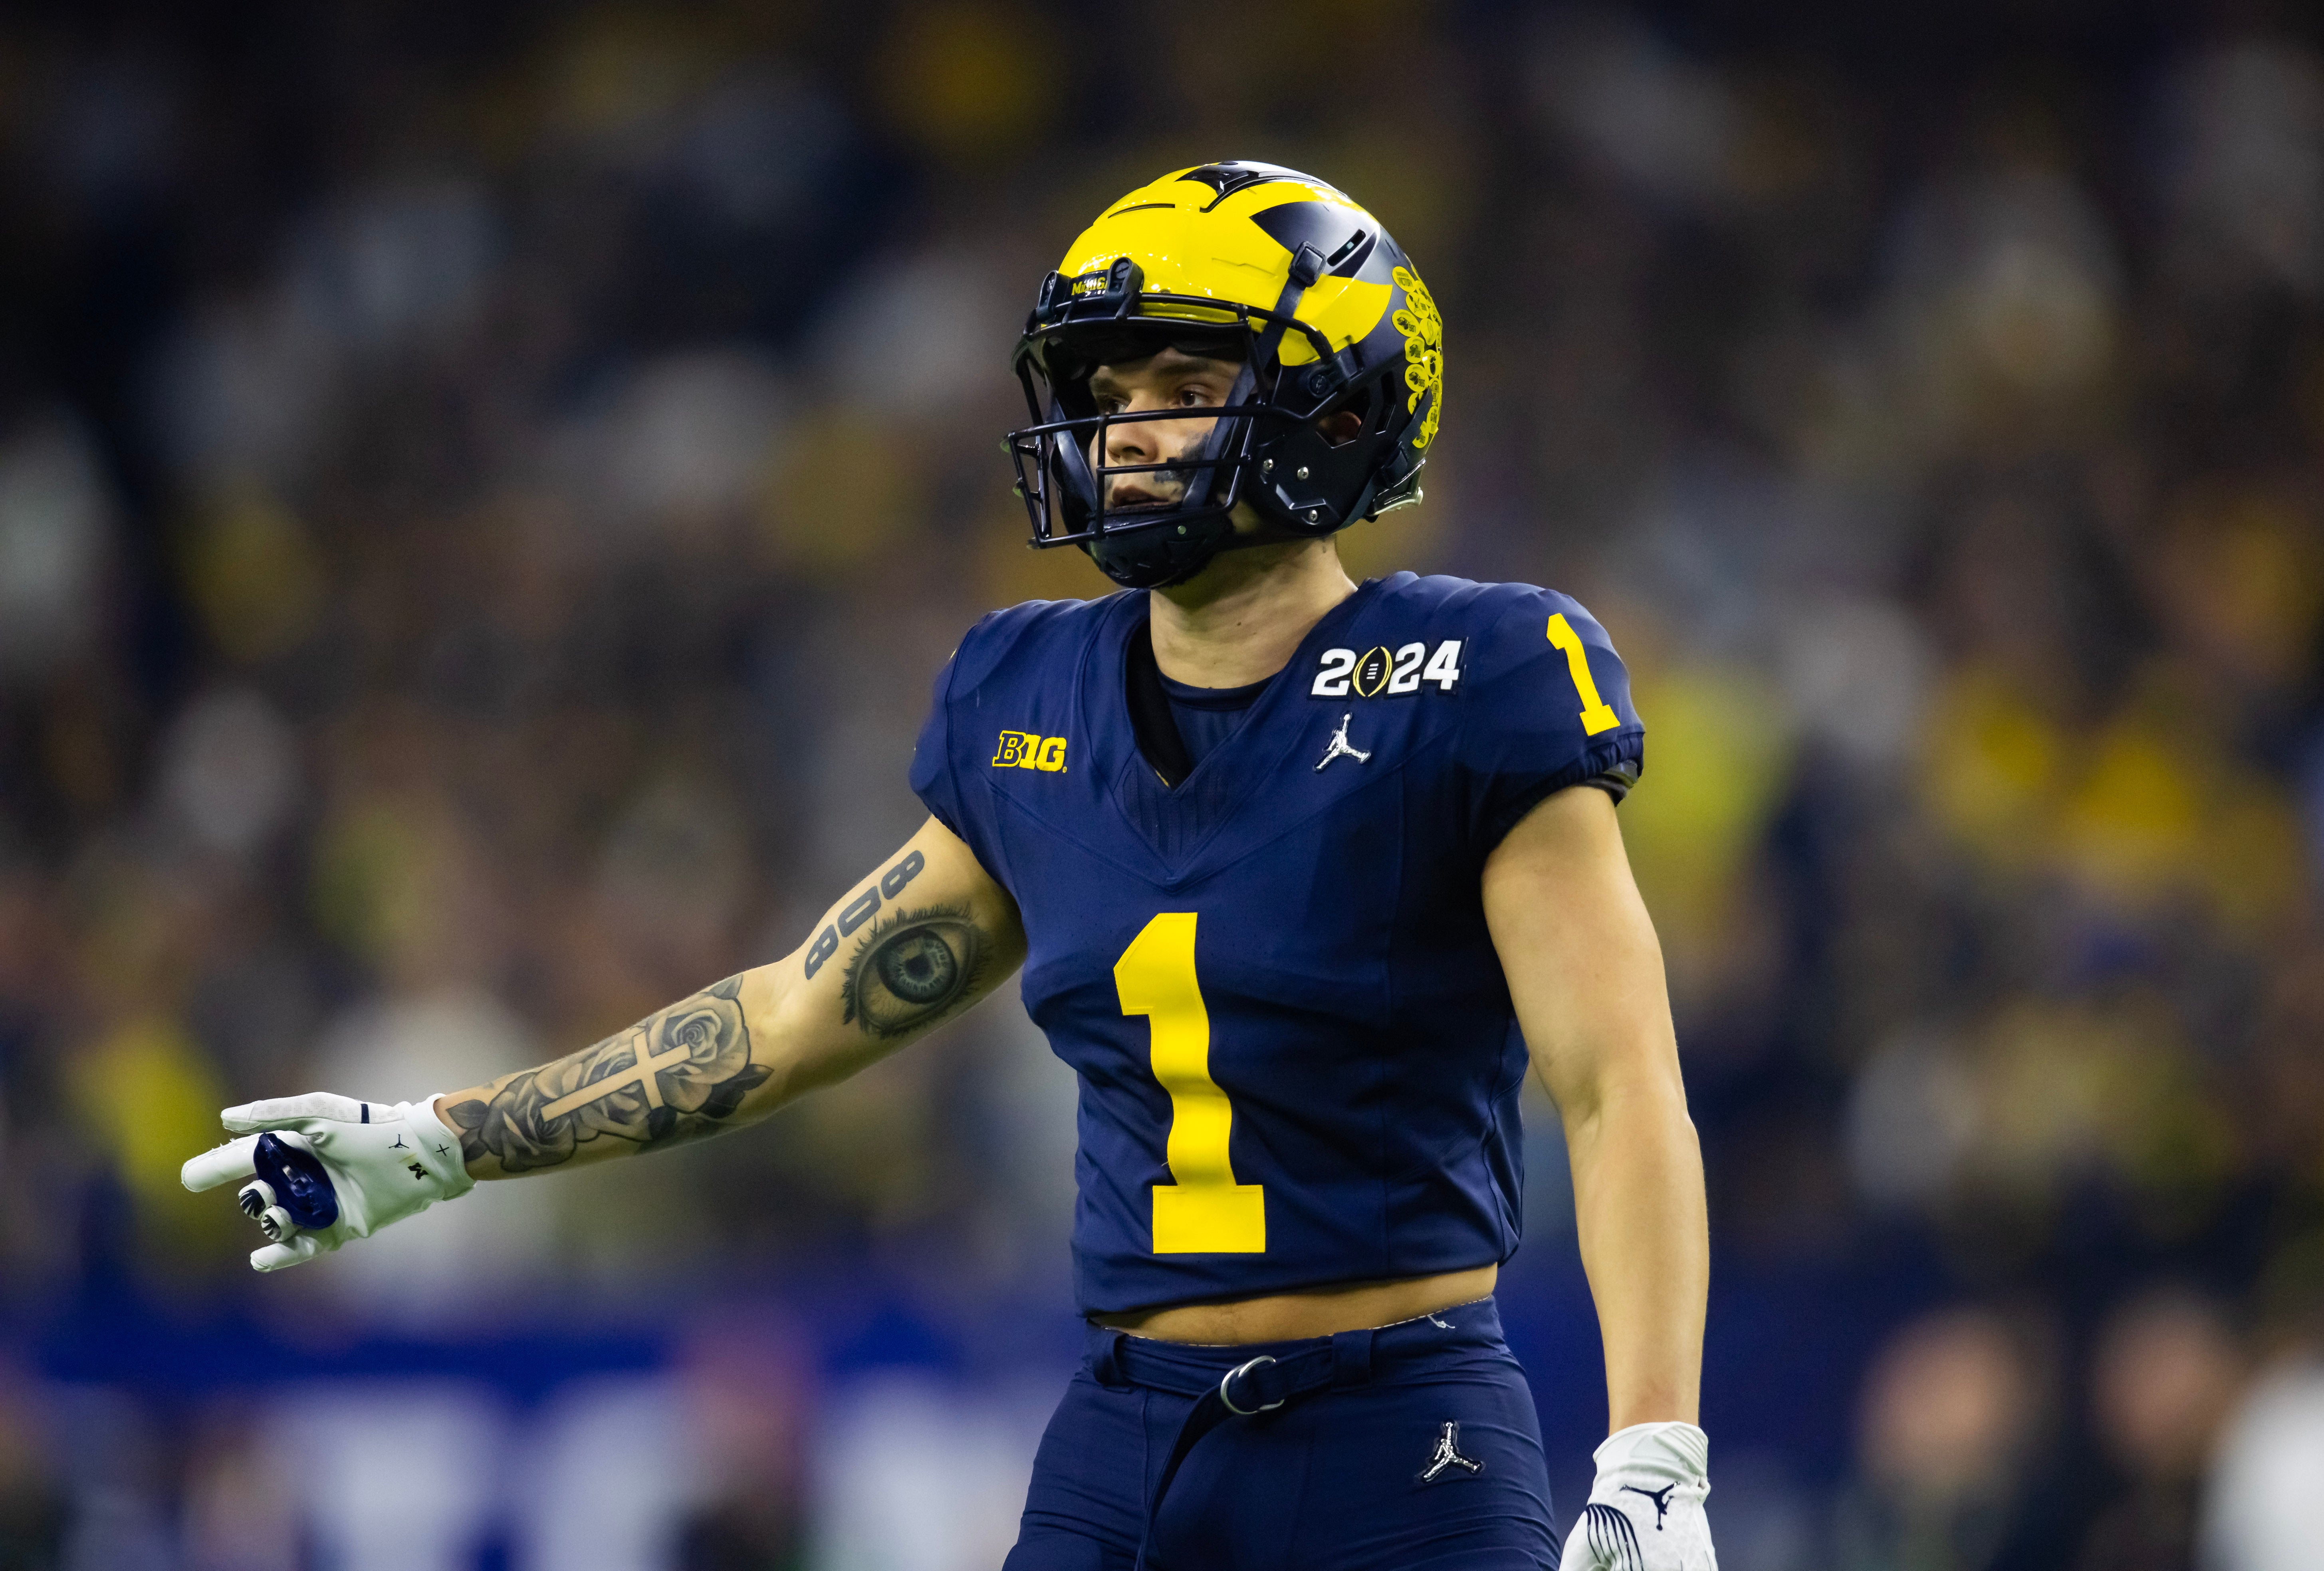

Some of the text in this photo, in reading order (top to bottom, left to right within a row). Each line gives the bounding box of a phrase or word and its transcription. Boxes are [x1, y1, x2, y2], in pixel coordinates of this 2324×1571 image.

[1311, 640, 1462, 697] 2024
[1546, 613, 1620, 736] 1
[804, 850, 925, 980] 808
[1113, 912, 1266, 1254] 1
[408, 1162, 429, 1181] M
